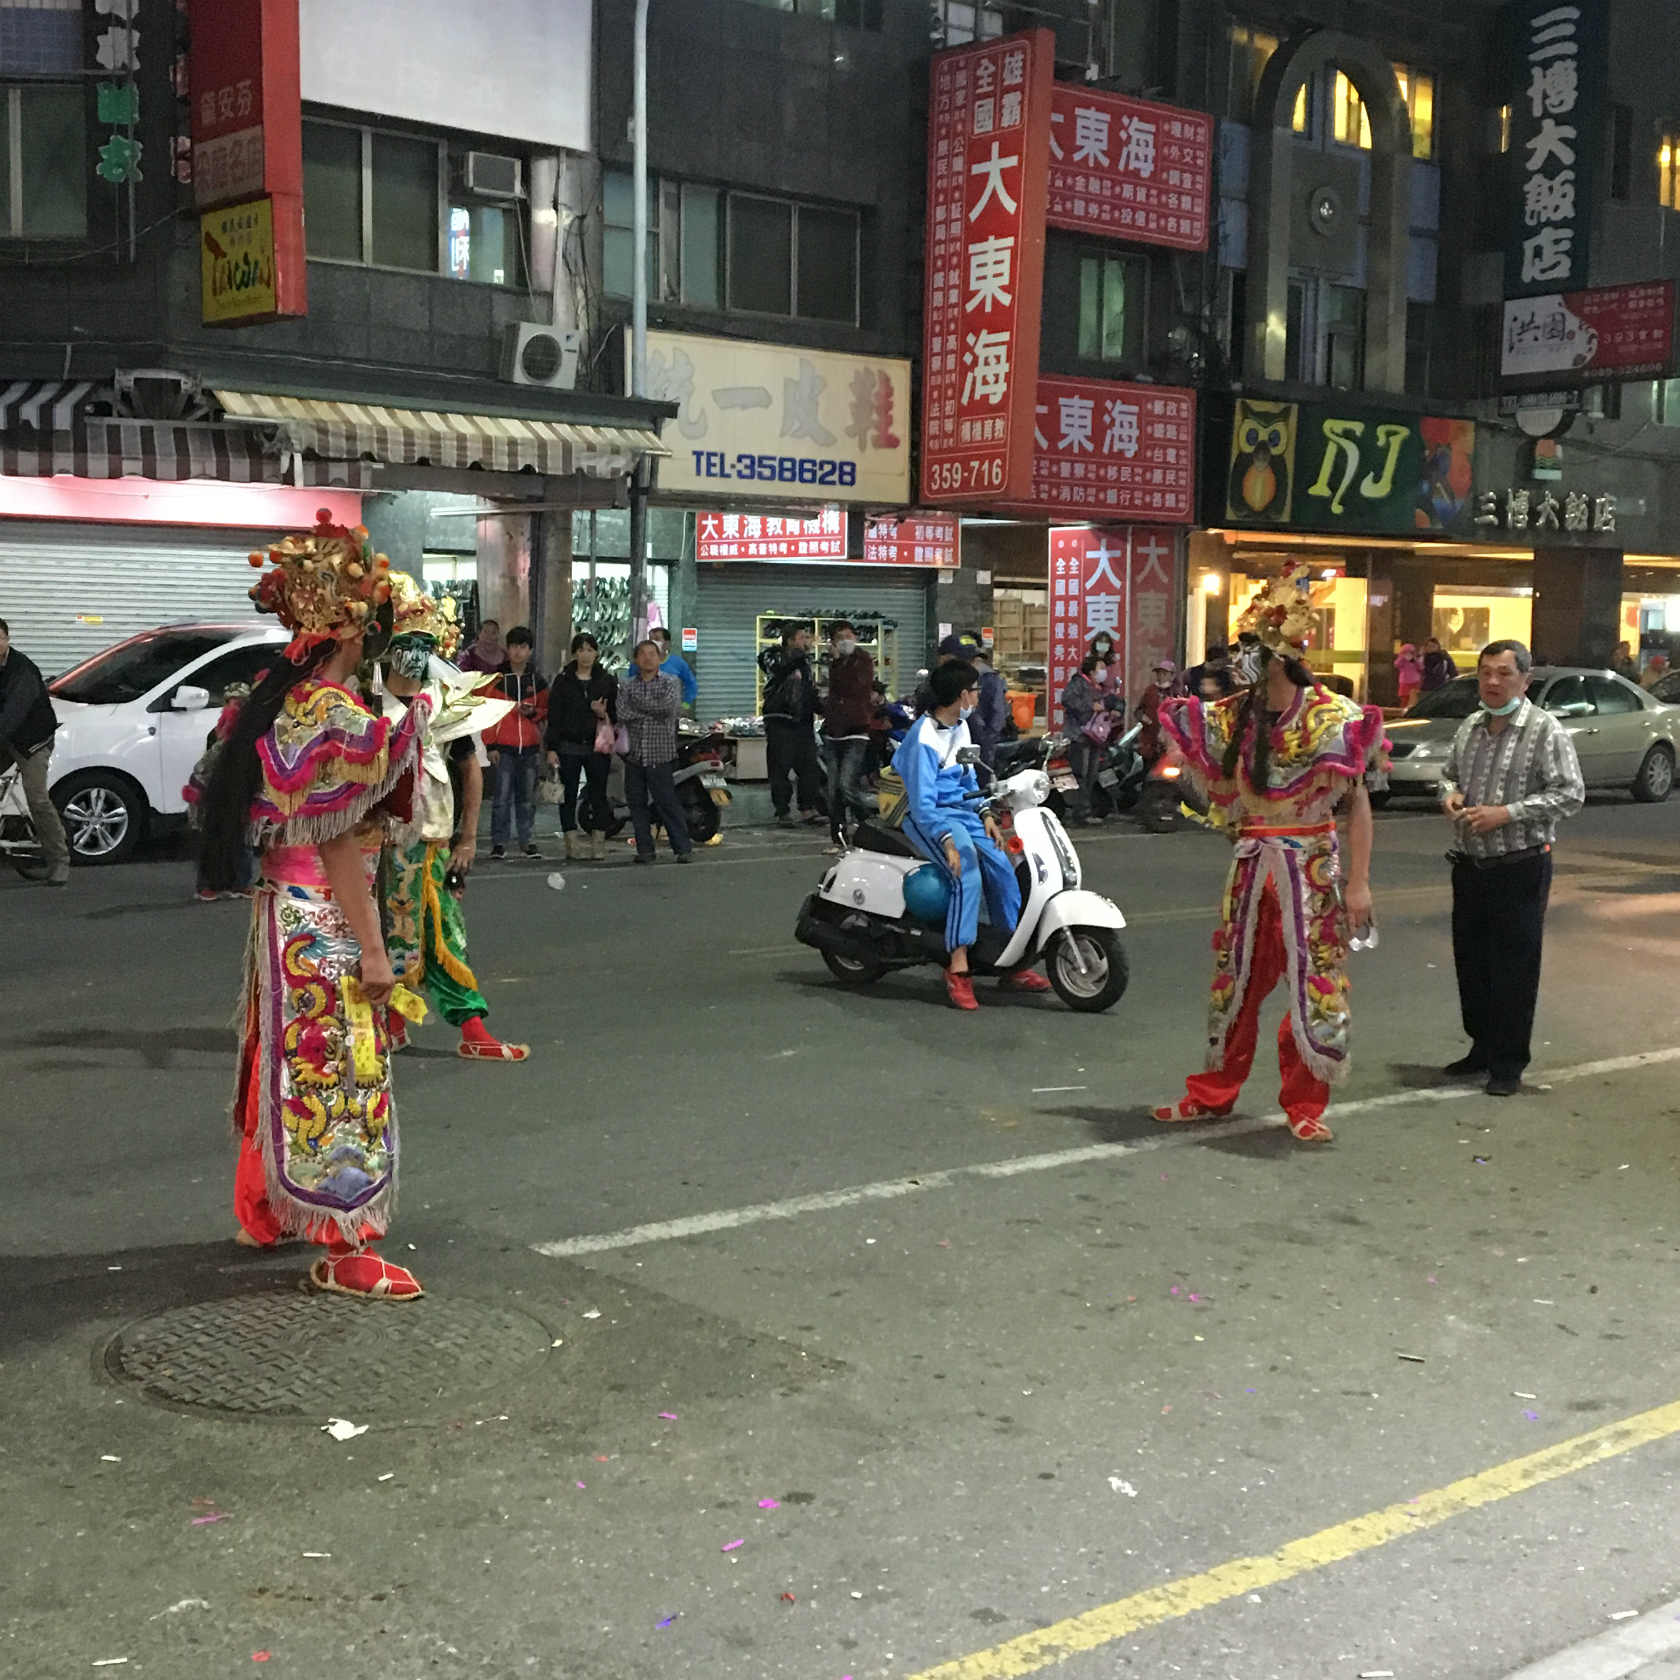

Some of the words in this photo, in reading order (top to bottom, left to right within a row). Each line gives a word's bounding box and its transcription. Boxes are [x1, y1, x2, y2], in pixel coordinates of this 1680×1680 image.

[974, 58, 995, 134] 全國
[1520, 5, 1582, 284] 三博大飯店
[960, 140, 1019, 407] 大東海
[930, 457, 1003, 491] 359-716
[1474, 489, 1617, 533] 三博大飯店
[865, 545, 897, 561] 法特考
[1084, 538, 1122, 655] 大東
